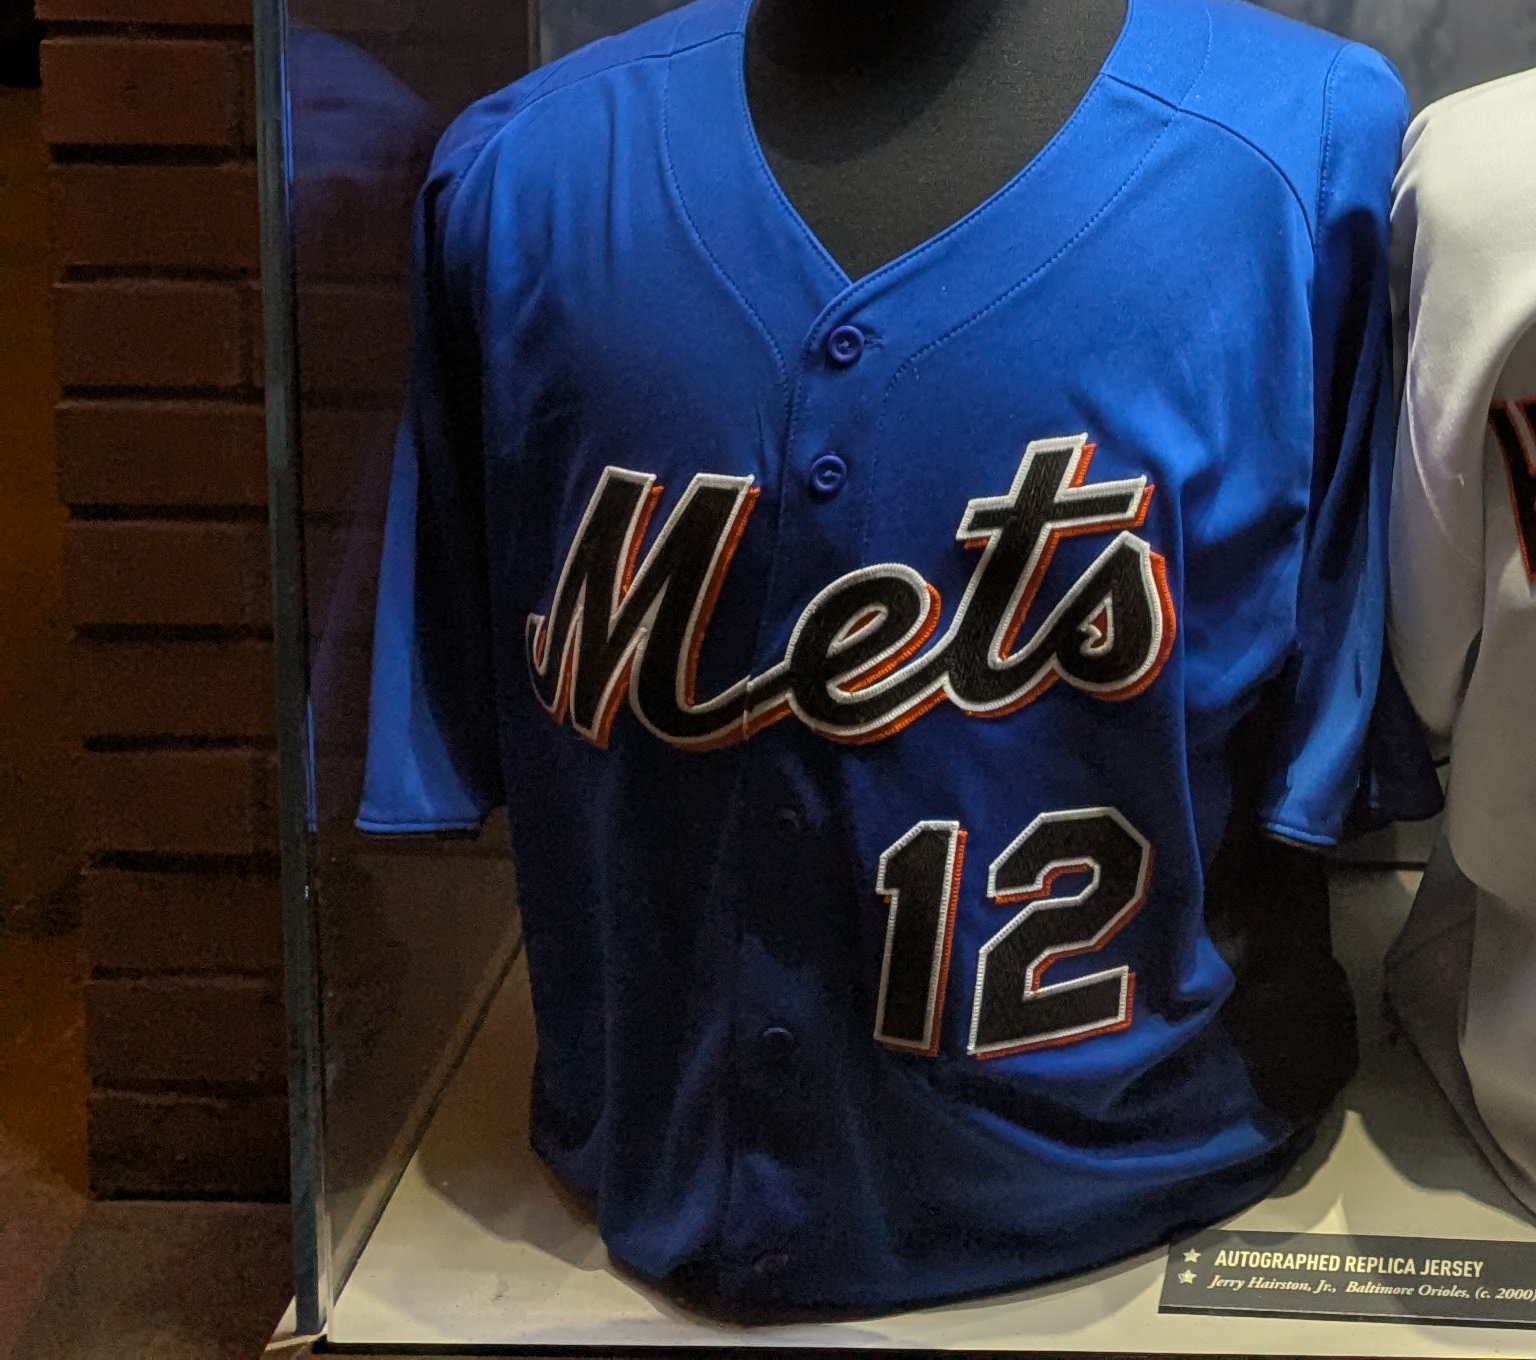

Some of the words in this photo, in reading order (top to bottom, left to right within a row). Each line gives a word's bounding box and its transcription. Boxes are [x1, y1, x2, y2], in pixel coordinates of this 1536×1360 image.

[526, 433, 1176, 749] Mets
[874, 806, 1153, 1060] 12
[1207, 1275, 1245, 1292] Jerry
[1248, 1277, 1311, 1294] Hairston,
[1313, 1279, 1337, 1295] Jr.,
[1346, 1280, 1414, 1297] Baltimore
[1418, 1284, 1470, 1300] Orioles,
[1474, 1286, 1491, 1301] (c.
[1214, 1250, 1340, 1272] AUTOGRAPHED
[1345, 1256, 1415, 1275] REPLICA
[1419, 1259, 1484, 1278] JERSEY
